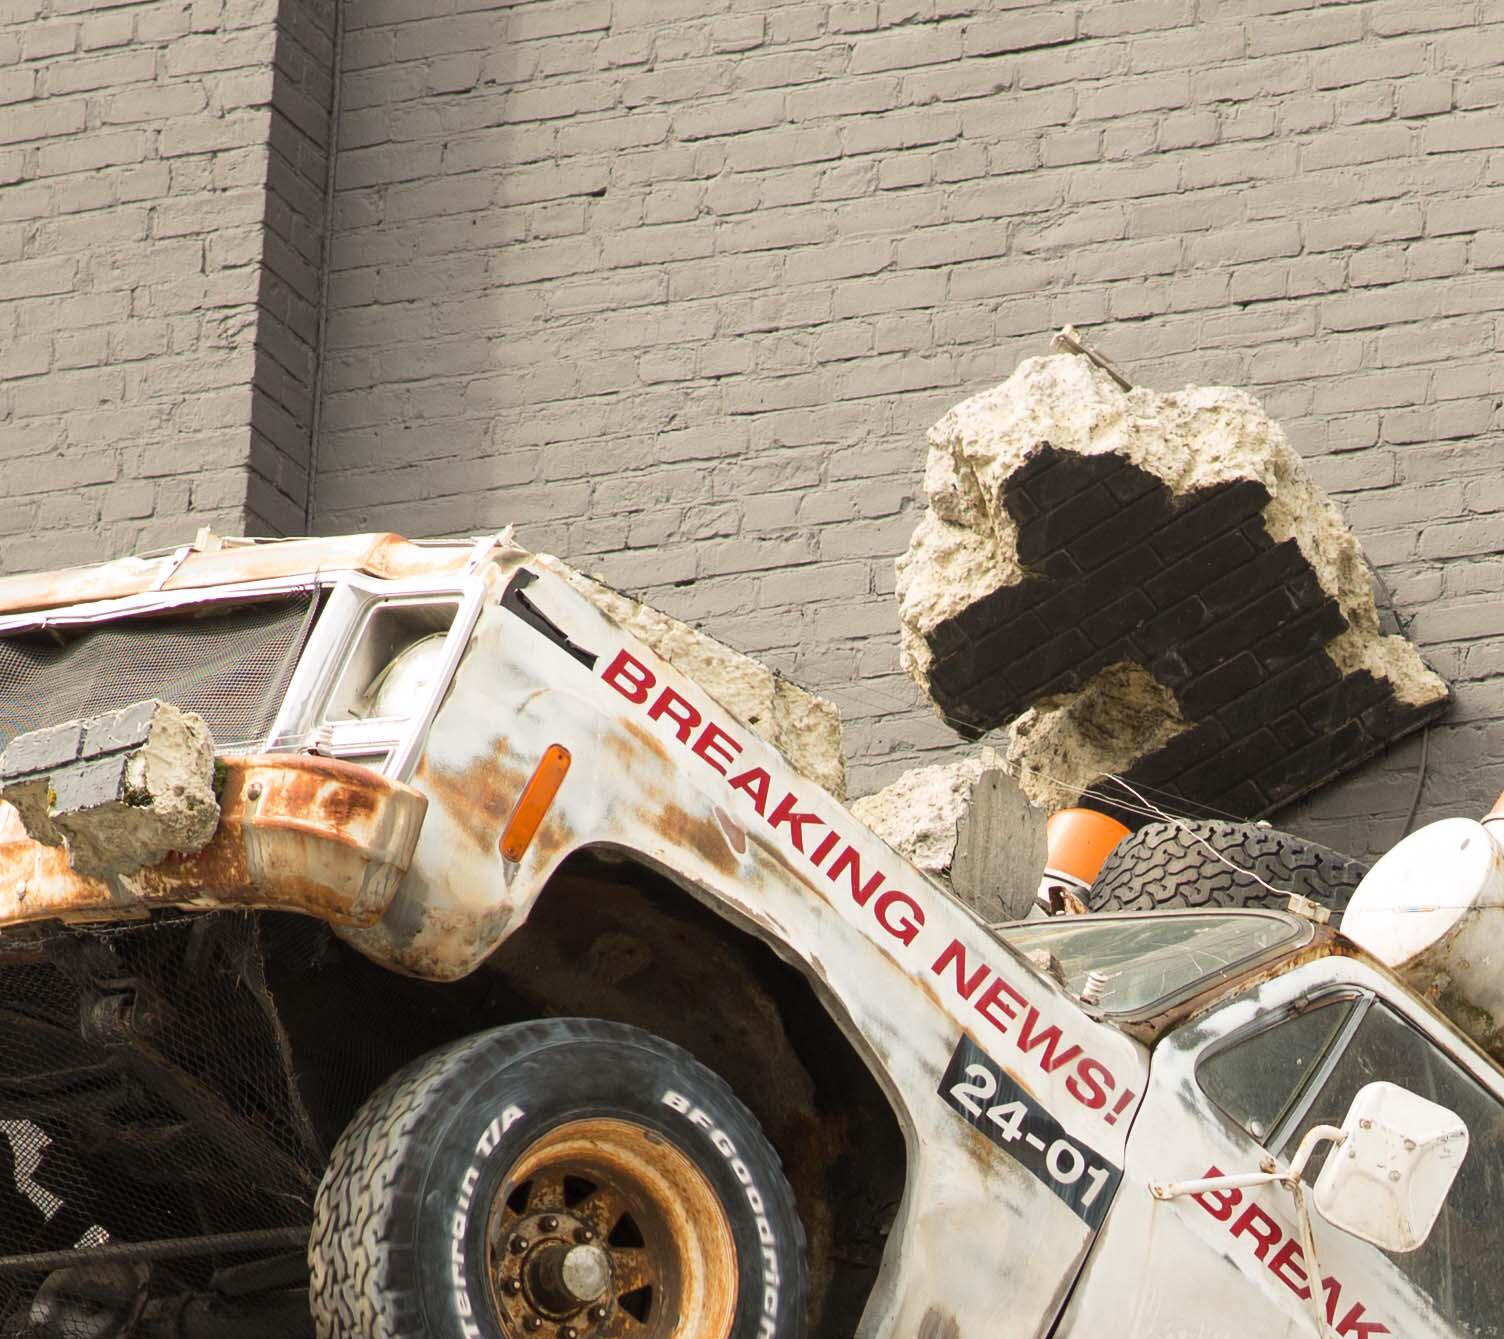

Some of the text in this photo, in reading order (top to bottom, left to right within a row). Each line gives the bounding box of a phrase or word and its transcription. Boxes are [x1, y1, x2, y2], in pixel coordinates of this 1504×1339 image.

[601, 649, 1136, 1126] BREAKING NEWS!
[475, 1104, 526, 1158] T/A
[950, 1064, 1110, 1208] 24-01
